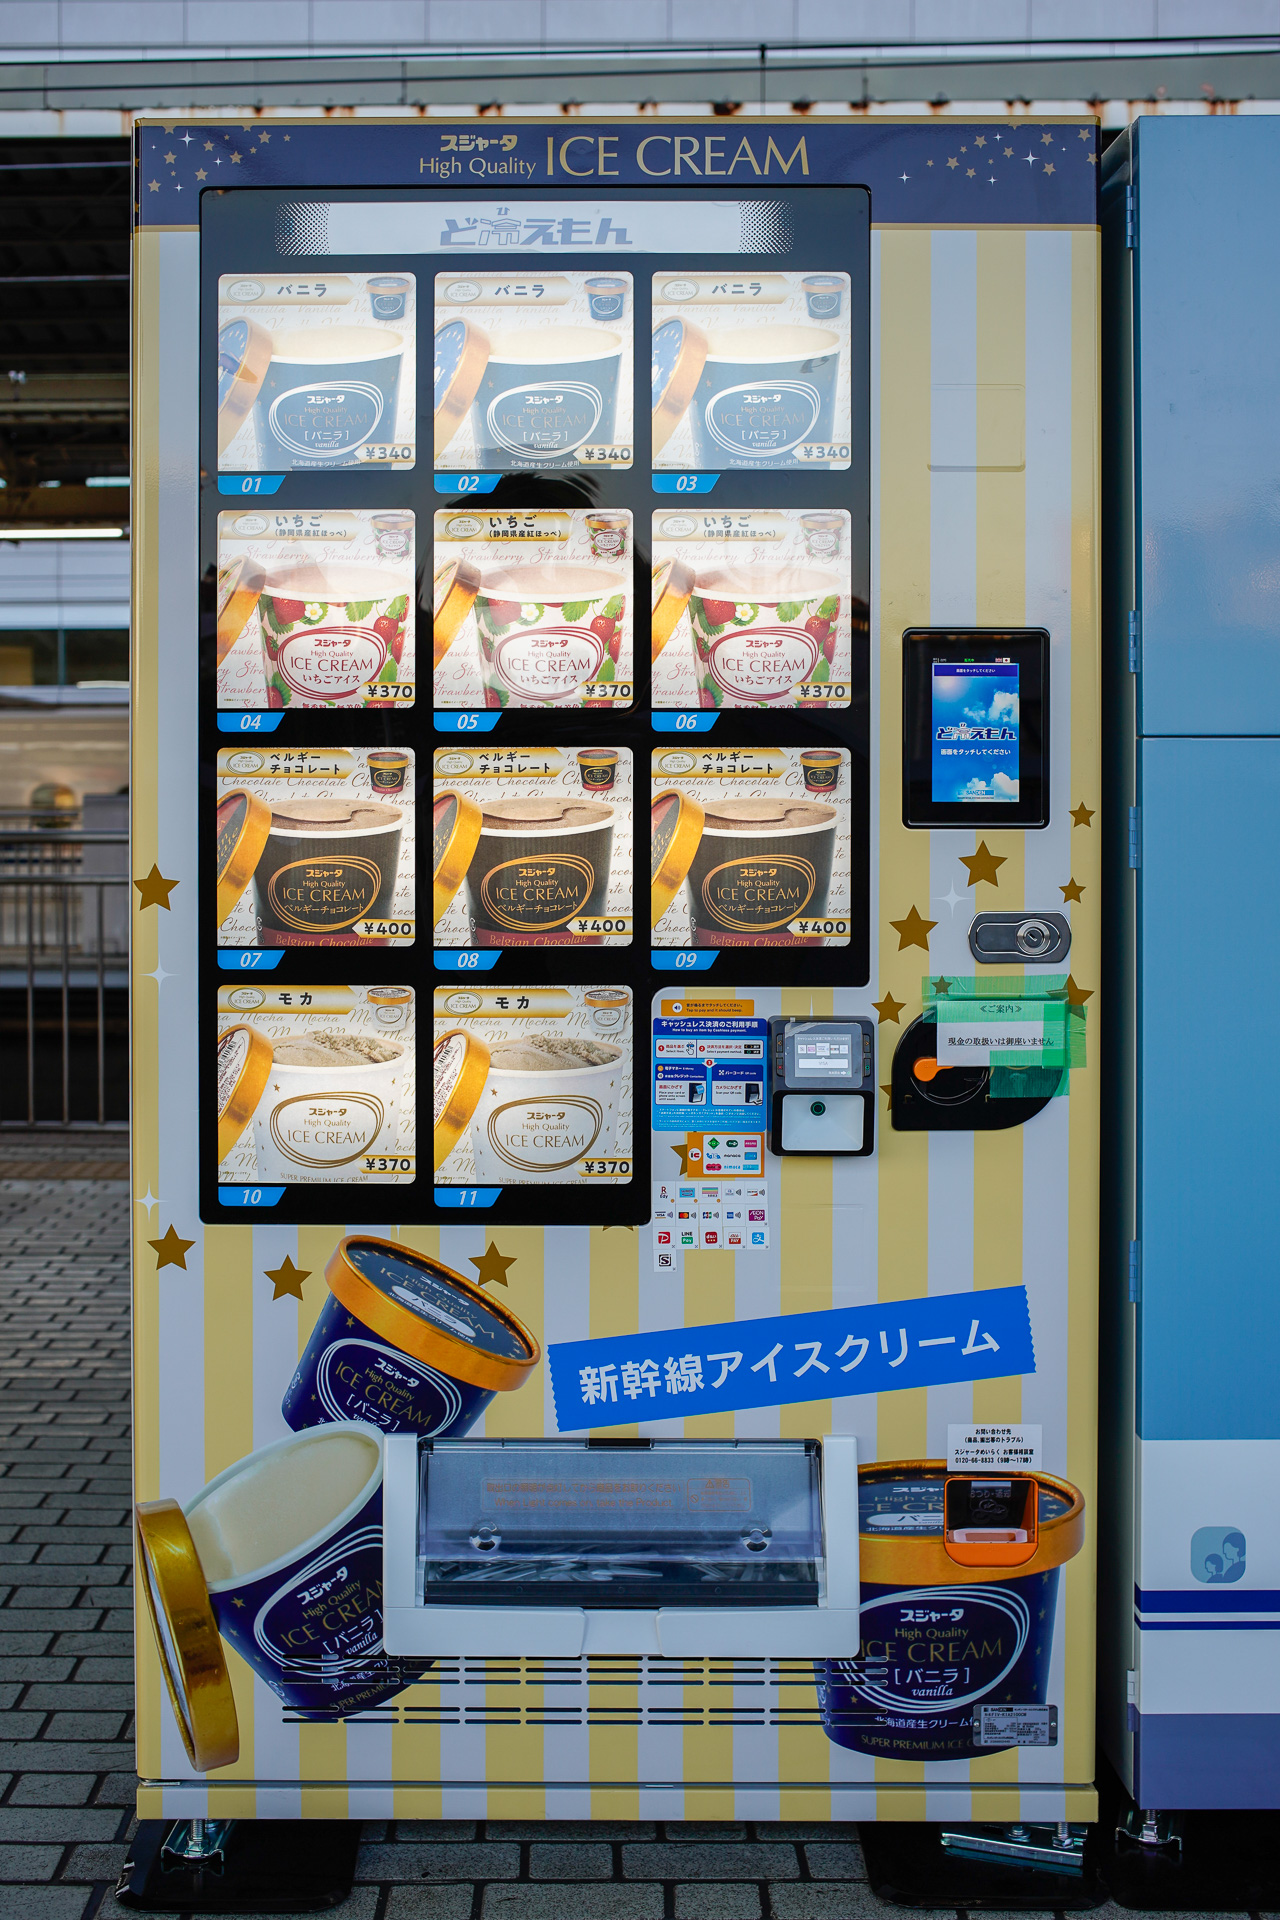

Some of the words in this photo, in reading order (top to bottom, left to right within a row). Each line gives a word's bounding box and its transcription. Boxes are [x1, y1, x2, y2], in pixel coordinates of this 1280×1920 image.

[440, 134, 517, 152] スジャータ
[420, 158, 461, 178] High
[469, 158, 536, 178] Quality
[547, 136, 619, 176] ICE
[636, 136, 809, 176] CREAM
[440, 217, 632, 246] ど冷えもん
[277, 284, 327, 297] バニラ
[495, 285, 545, 298] バニラ
[712, 283, 762, 296] バニラ
[307, 395, 345, 404] スジャータ
[525, 395, 563, 404] スジャータ
[541, 407, 566, 415] Quality
[502, 414, 524, 428] ICE
[531, 413, 587, 428] CREAM
[304, 431, 348, 441] [バニラ]
[523, 431, 567, 441] [バニラ]
[366, 447, 411, 459] ¥340
[585, 448, 630, 460] ¥340
[804, 446, 849, 459] ¥340
[511, 460, 580, 468] 北海道産生クリーム使用
[242, 478, 261, 492] 01
[457, 476, 479, 491] 02
[676, 476, 697, 491] 03
[276, 515, 322, 527] いちご
[490, 516, 537, 528] いちご
[704, 515, 751, 527] いちご
[275, 529, 347, 537] (静岡県産紅ほっぺ)
[489, 530, 561, 538] (静岡県産紅ほっぺ)
[703, 529, 776, 537] (静岡県産紅ほっぺ)
[314, 639, 351, 647] スジャータ
[531, 640, 568, 648] スジャータ
[311, 650, 327, 658] High
[291, 656, 311, 670] ICE
[318, 658, 373, 672] CREAM
[508, 658, 529, 671] ICE
[535, 658, 590, 672] CREAM
[303, 674, 360, 684] いちごアイス
[521, 675, 577, 685] いちごアイス
[735, 675, 792, 685] いちごアイス
[368, 685, 412, 698] ¥370
[586, 685, 630, 697] ¥370
[801, 685, 845, 697] ¥370
[240, 715, 261, 729] 04
[457, 715, 478, 729] 05
[676, 714, 697, 729] 06
[270, 752, 321, 762] ベルギー
[479, 752, 530, 761] ベルギー
[703, 752, 753, 761] ベルギー
[271, 765, 340, 775] チョコレート
[480, 764, 550, 774] チョコレート
[703, 764, 773, 774] チョコレート
[306, 869, 342, 878] スジャータ
[519, 868, 556, 877] スジャータ
[321, 880, 345, 888] Quality
[534, 879, 558, 887] Quality
[283, 888, 304, 901] ICE
[310, 888, 365, 902] CREAM
[496, 887, 518, 900] ICE
[523, 886, 578, 901] CREAM
[284, 904, 363, 914] ベルギーチョコレート
[498, 902, 577, 913] ベルギーチョコレート
[718, 903, 798, 913] ベルギーチョコレート
[364, 922, 411, 935] ¥400
[578, 920, 625, 932] ¥400
[799, 921, 846, 934] ¥400
[276, 935, 315, 946] Belgian
[319, 936, 373, 946] Chocolate
[240, 953, 262, 967] 07
[457, 953, 479, 967] 08
[675, 953, 697, 967] 09
[279, 993, 312, 1005] モカ
[495, 996, 529, 1009] モカ
[948, 1037, 1053, 1045] 現金の取扱いは御座いません
[309, 1108, 347, 1116] スジャータ
[527, 1112, 566, 1120] スジャータ
[324, 1119, 351, 1127] Quality
[542, 1123, 569, 1131] Quality
[287, 1130, 310, 1143] ICE
[315, 1131, 366, 1144] CREAM
[506, 1134, 528, 1147] ICE
[533, 1135, 584, 1148] CREAM
[366, 1159, 410, 1171] ¥370
[585, 1162, 630, 1174] ¥370
[243, 1189, 261, 1204] 10
[460, 1191, 477, 1205] 11
[579, 1319, 1001, 1405] 新幹線アイスクリーム
[374, 1358, 419, 1387] スジャータ
[365, 1368, 383, 1384] High
[385, 1381, 414, 1400] Quality
[336, 1361, 363, 1389] ICE
[365, 1385, 432, 1426] CREAM
[347, 1394, 400, 1431] [バニラ]
[494, 1499, 520, 1507] When
[523, 1499, 545, 1508] Light
[597, 1499, 616, 1507] take
[619, 1499, 633, 1507] the
[297, 1566, 348, 1605] スジャータ
[302, 1603, 327, 1620] High
[328, 1580, 361, 1606] Quality
[901, 1609, 964, 1622] スジャータ
[280, 1624, 320, 1647] ICE
[895, 1628, 922, 1641] High
[926, 1628, 968, 1639] Quality
[346, 1632, 378, 1655] vanilla
[861, 1640, 897, 1662] ICE
[908, 1638, 1001, 1663] CREAM
[895, 1668, 969, 1685] [バニラ]
[912, 1685, 953, 1696] vanilla
[861, 1735, 890, 1747] SUPER
[893, 1740, 944, 1749] PREMIUM
[947, 1740, 962, 1748] ICE
